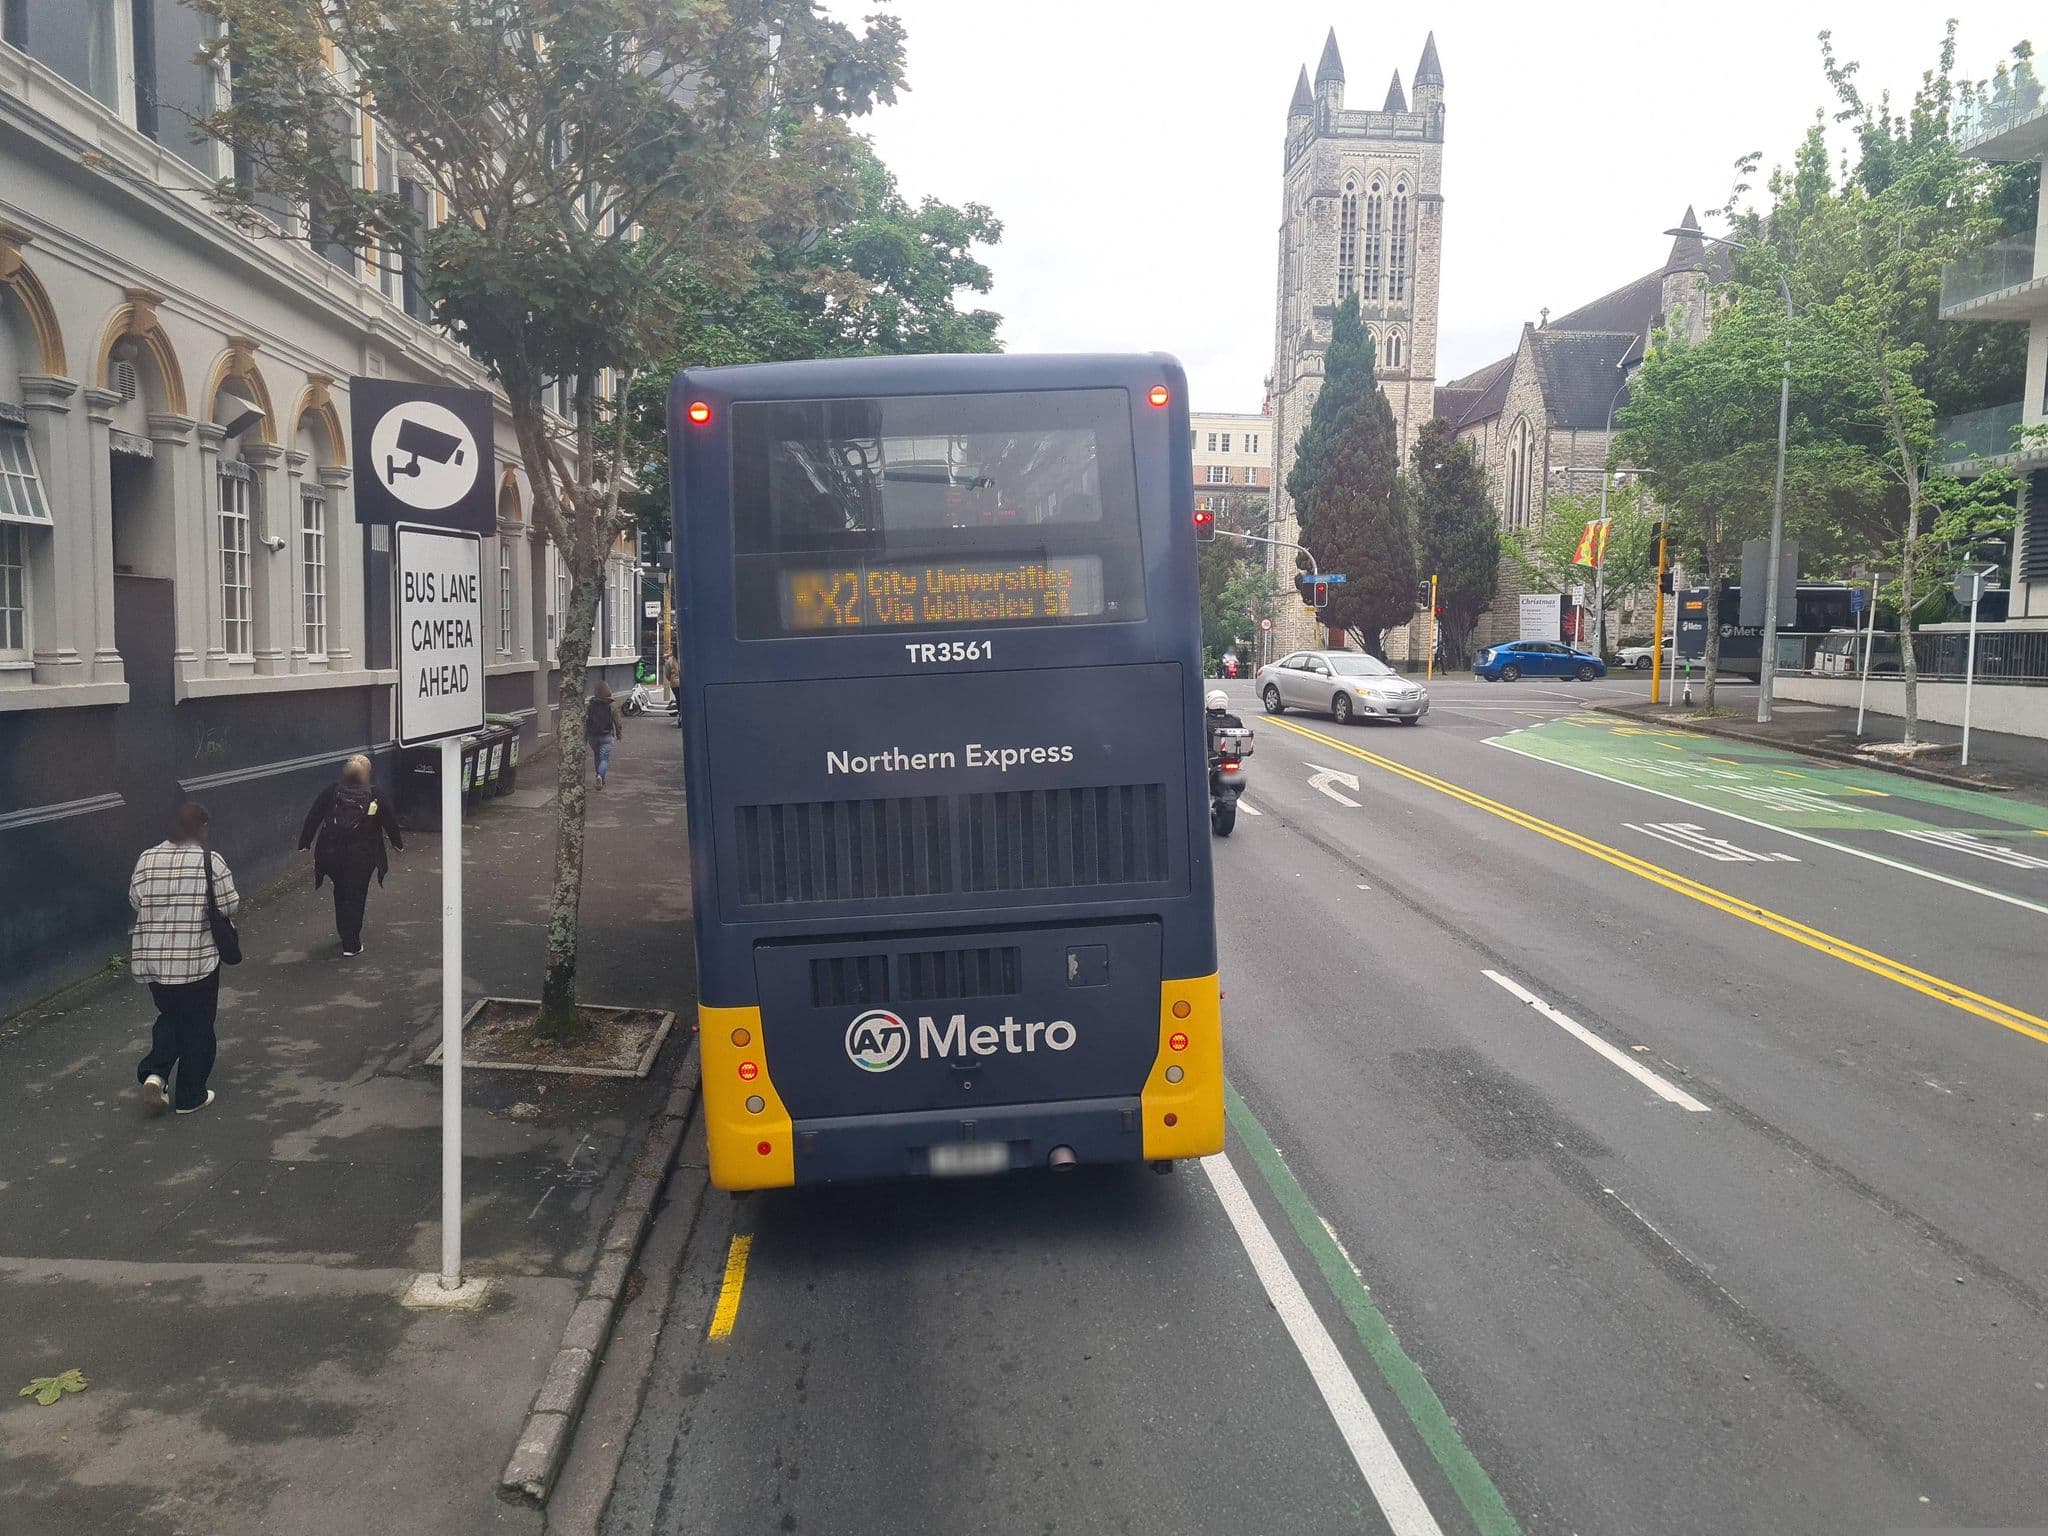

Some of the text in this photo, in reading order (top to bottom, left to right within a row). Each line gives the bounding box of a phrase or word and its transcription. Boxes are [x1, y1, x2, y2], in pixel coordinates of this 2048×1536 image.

[405, 571, 477, 603] BUS LANE
[867, 565, 1072, 596] City Universities
[875, 590, 1070, 623] Via Wellesley St
[411, 619, 474, 651] CAMERA
[1733, 626, 1765, 636] Meto
[905, 640, 993, 663] TR3561
[418, 664, 469, 698] AHEAD
[827, 743, 1074, 775] Northern Express
[918, 1014, 1078, 1059] Metro
